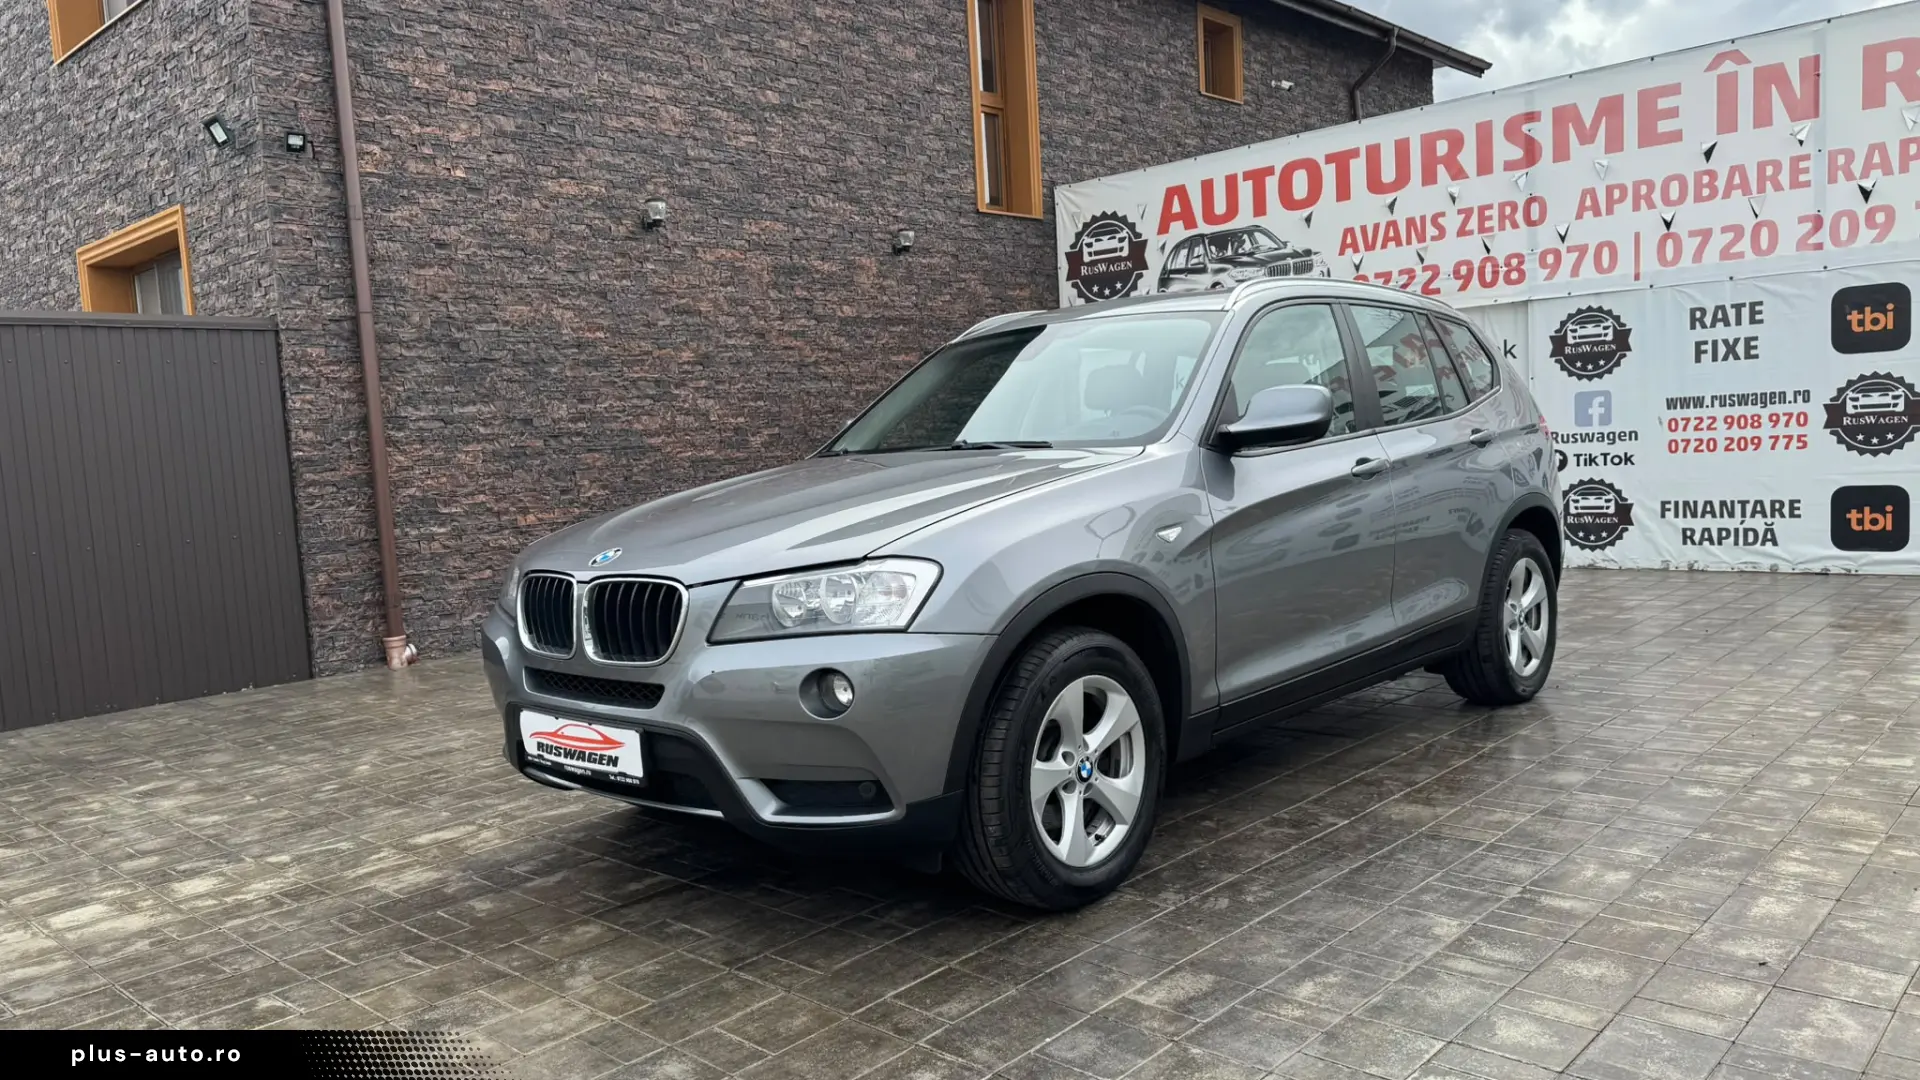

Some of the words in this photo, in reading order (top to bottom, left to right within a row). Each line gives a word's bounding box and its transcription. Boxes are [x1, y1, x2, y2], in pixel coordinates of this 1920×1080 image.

[1157, 82, 1683, 235] AUTOTURISME
[1704, 49, 1820, 135] ÎN
[1575, 153, 1811, 220] APROBARE
[1338, 211, 1447, 256] AVANS
[1456, 195, 1548, 238] ZERO
[1452, 252, 1527, 292] 908
[1538, 240, 1618, 281] 970
[1656, 219, 1779, 267] 0720
[1796, 204, 1896, 252] 209
[1689, 301, 1764, 331] RATE
[1847, 303, 1895, 332] tbi
[1694, 336, 1760, 364] FIXE
[1665, 389, 1811, 410] www.ruswagen.ro
[1667, 416, 1718, 433] 0722
[1723, 413, 1762, 430] 908
[1768, 411, 1809, 428] 970
[1551, 430, 1639, 445] Ruswagen
[1667, 437, 1718, 454] 0720
[1723, 436, 1762, 452] 209
[1768, 434, 1808, 450] 775
[1846, 505, 1893, 532] tbi
[537, 741, 619, 767] RUSWAGEN
